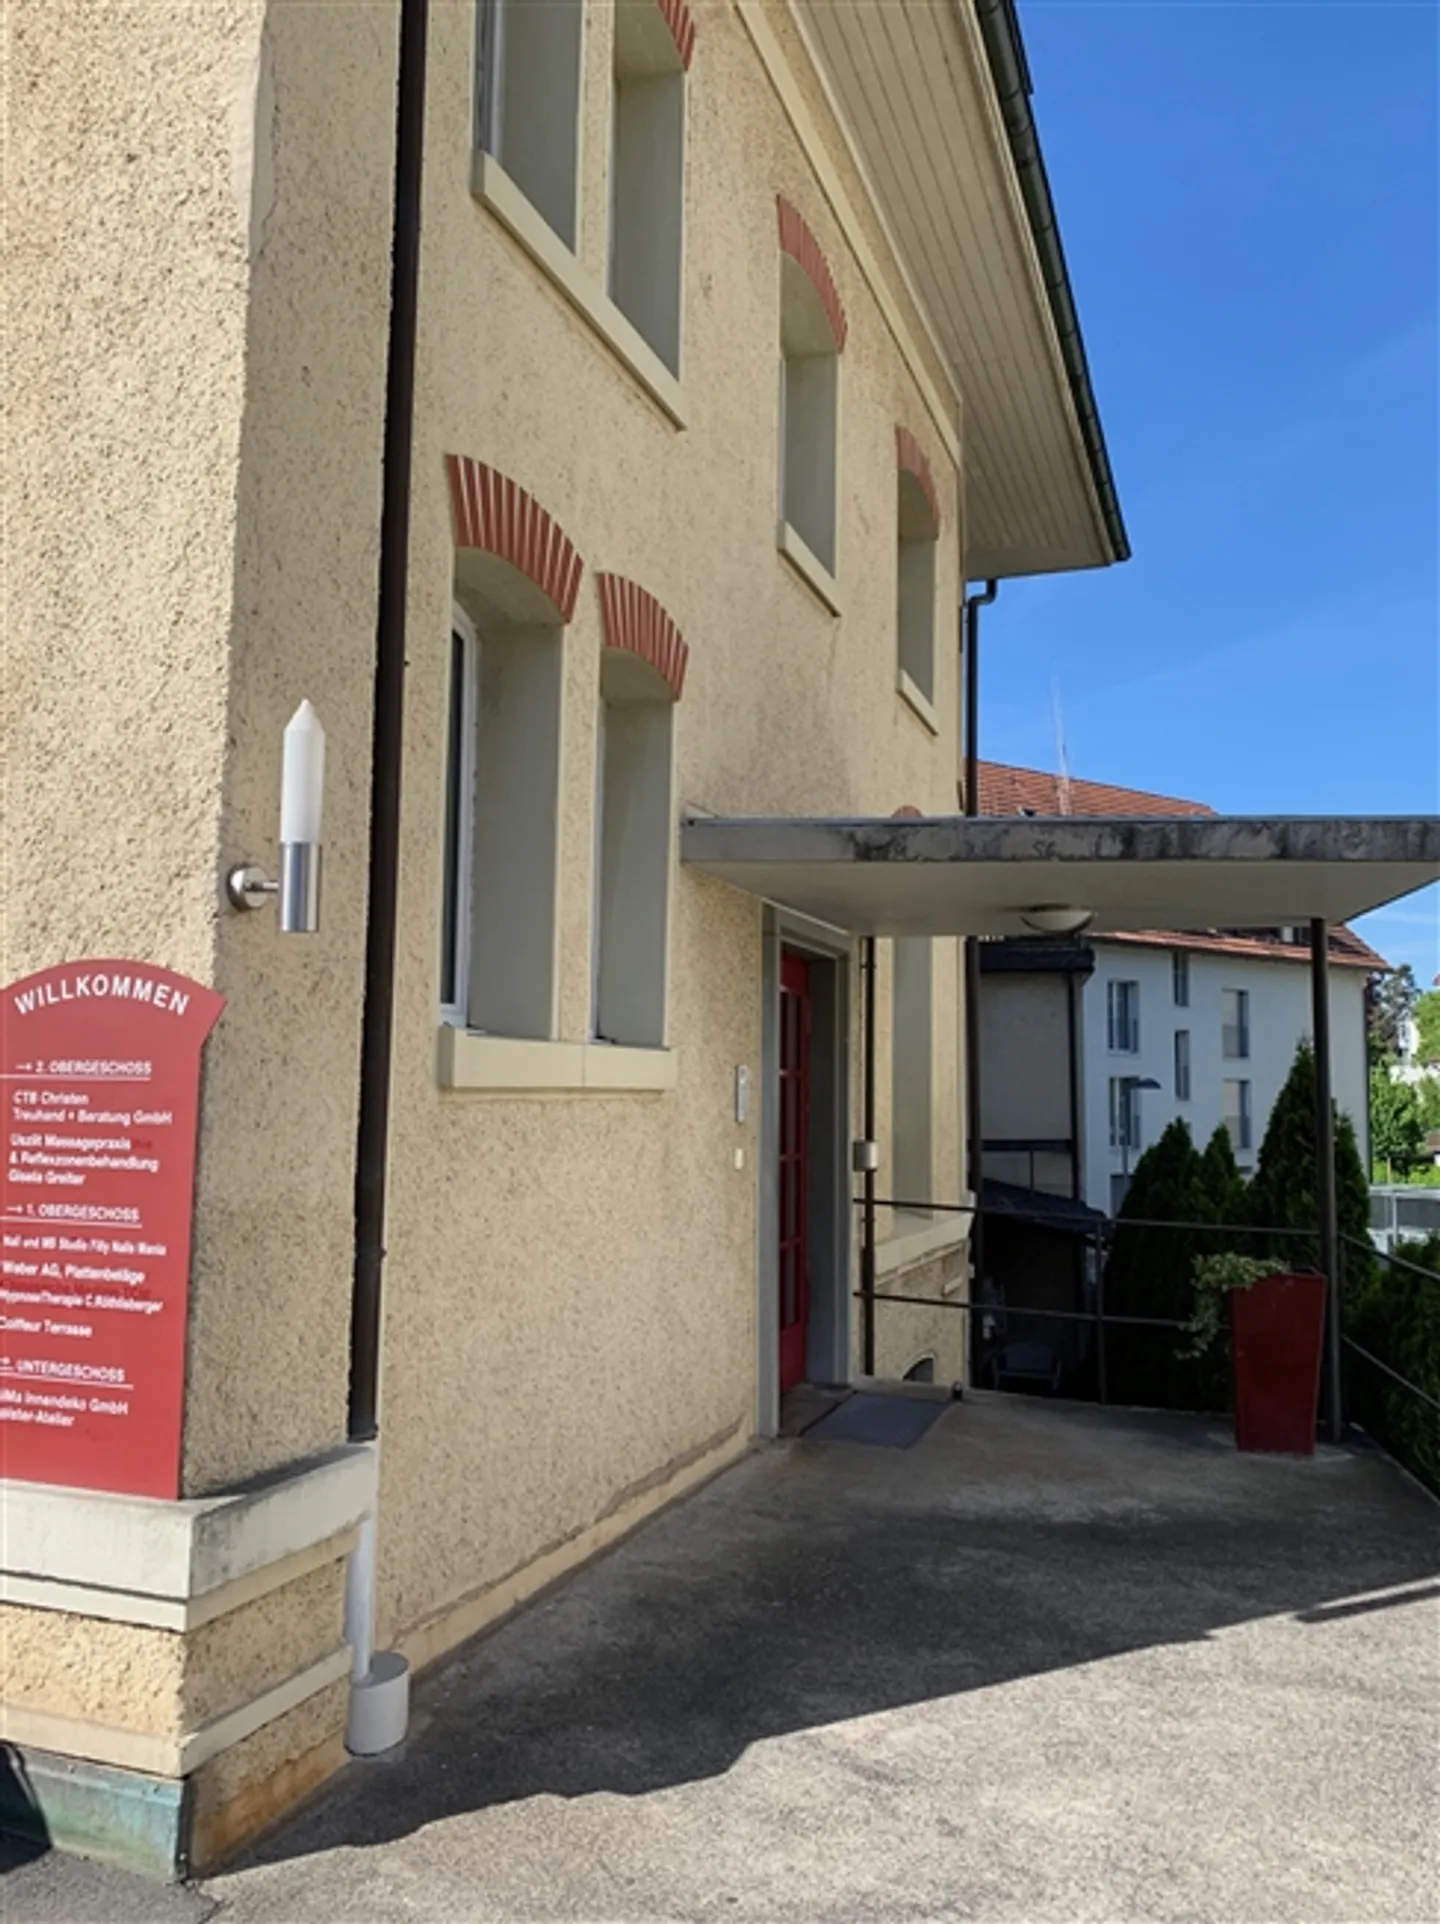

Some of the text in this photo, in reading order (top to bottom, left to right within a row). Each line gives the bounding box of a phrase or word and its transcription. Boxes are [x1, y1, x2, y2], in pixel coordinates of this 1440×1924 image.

[14, 974, 190, 1016] WILLKOMMEN
[49, 1060, 152, 1075] OBERGESCHOSS
[13, 1108, 66, 1122] Treuhand
[77, 1109, 131, 1127] Beratung
[133, 1111, 173, 1125] GmbH
[44, 1134, 131, 1151] Massagepraxis
[38, 1204, 140, 1222] OBERGESCHOSS
[65, 1263, 145, 1286] Plattenbeläge
[44, 1318, 93, 1337] Terrasse
[16, 1359, 126, 1382] UNTERGESCHOSS
[89, 1397, 129, 1415] GmbH
